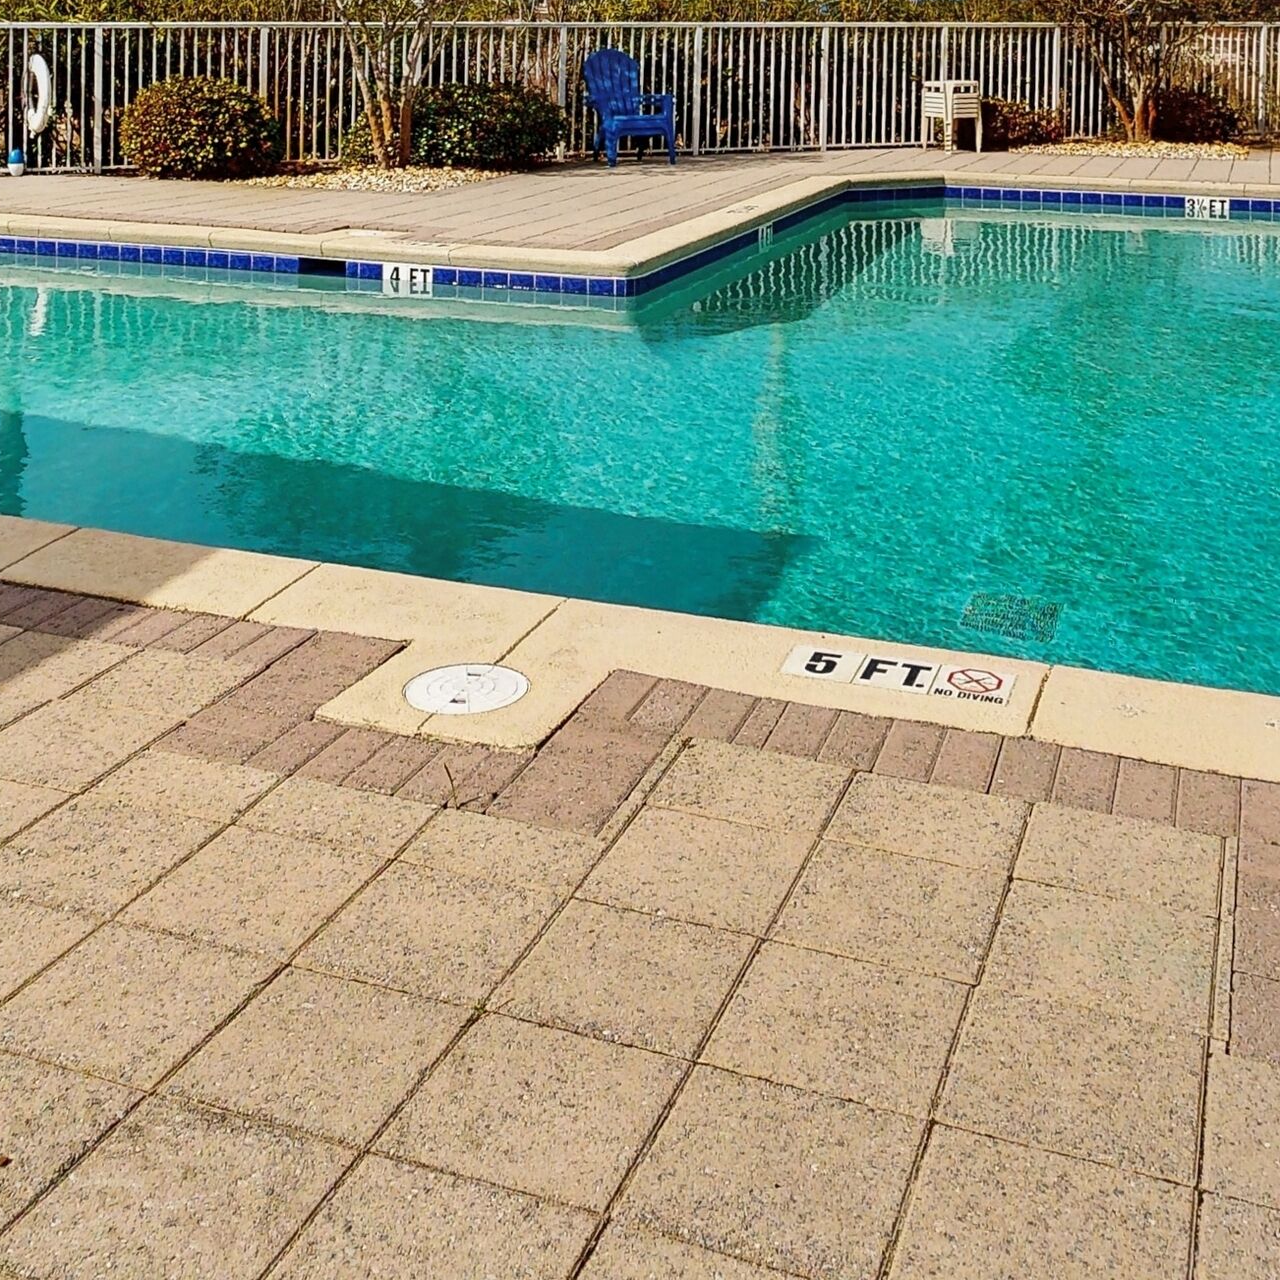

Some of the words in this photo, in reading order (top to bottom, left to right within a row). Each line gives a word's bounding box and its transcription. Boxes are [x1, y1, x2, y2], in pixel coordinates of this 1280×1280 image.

[389, 266, 401, 281] 4
[804, 651, 843, 675] 5
[933, 687, 953, 697] NO
[957, 691, 1005, 705] DIVING
